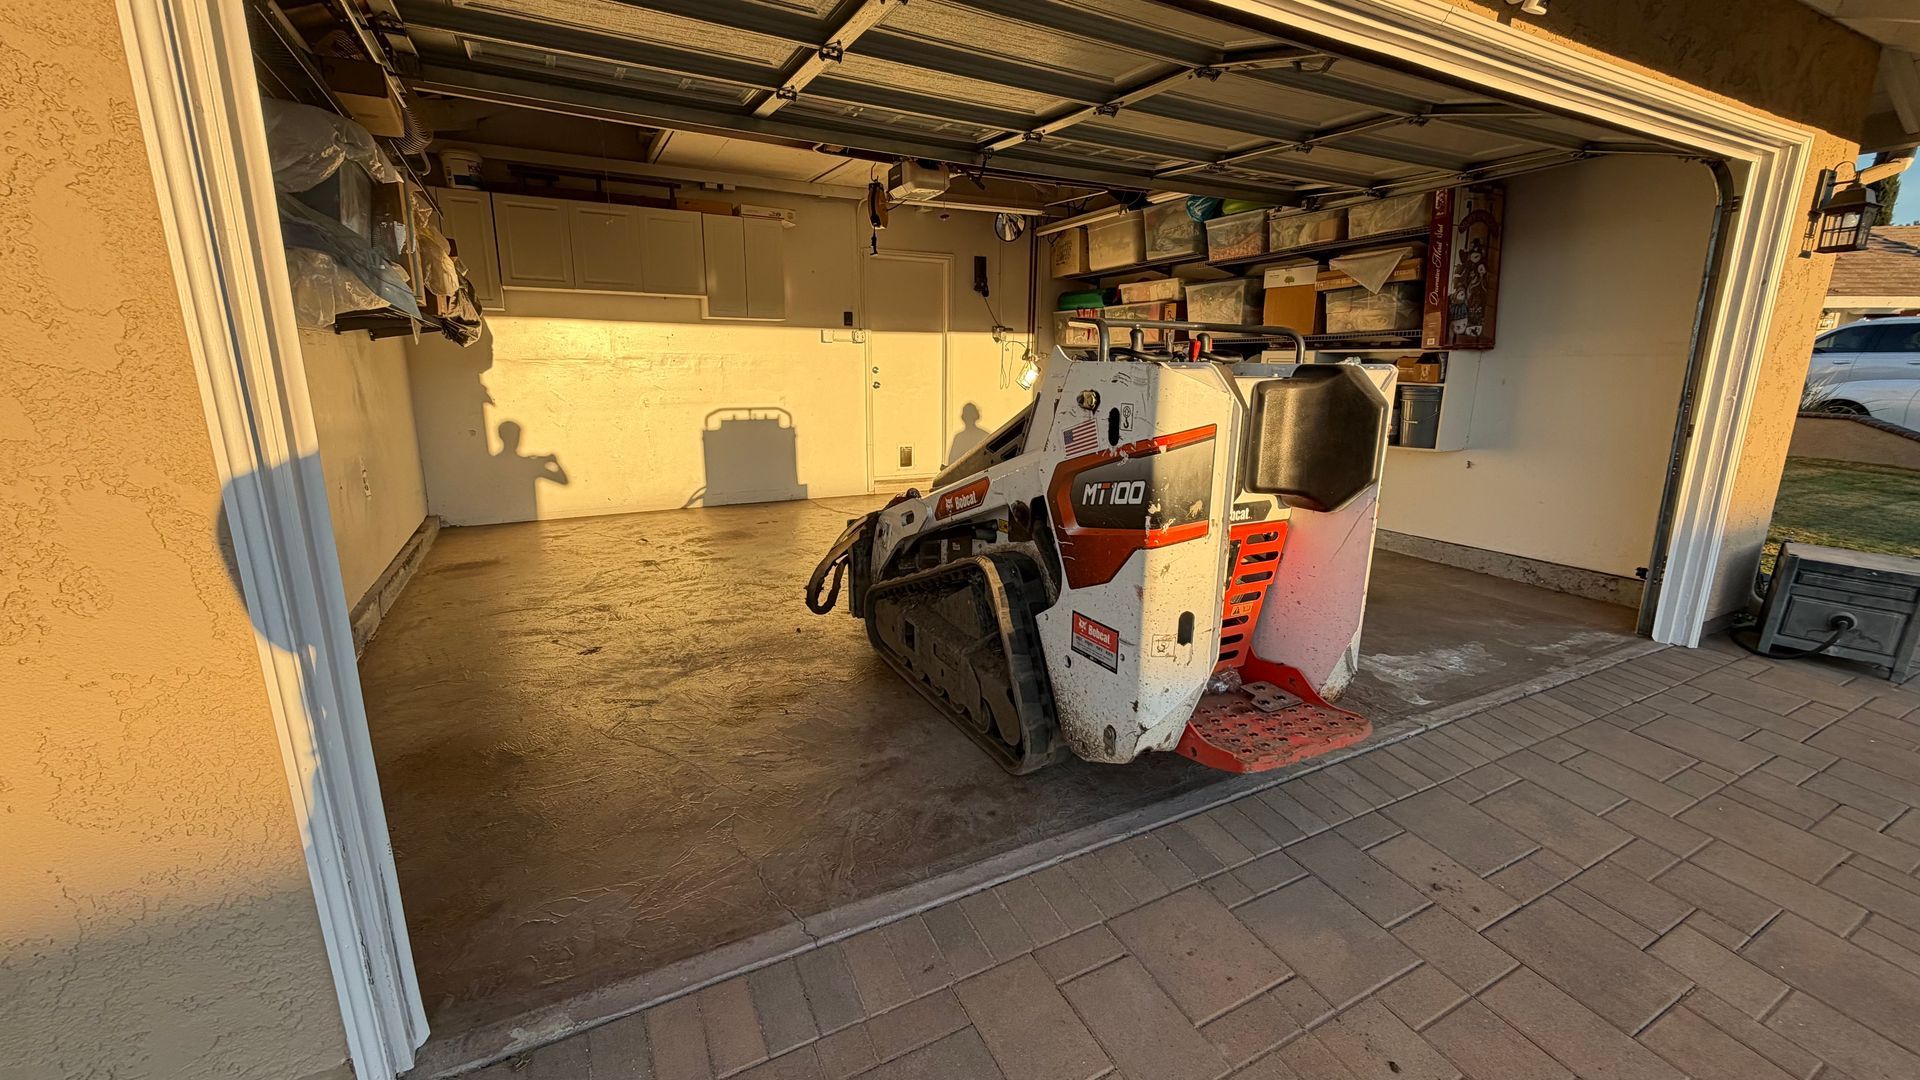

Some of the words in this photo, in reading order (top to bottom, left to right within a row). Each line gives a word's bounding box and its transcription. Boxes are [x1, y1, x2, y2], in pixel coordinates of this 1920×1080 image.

[1432, 242, 1443, 268] Metal
[1429, 269, 1441, 306] Decorative
[955, 491, 977, 510] Bobcat
[1082, 480, 1146, 505] MT100
[1230, 507, 1249, 521] bcat
[1088, 624, 1110, 645] Bobcat
